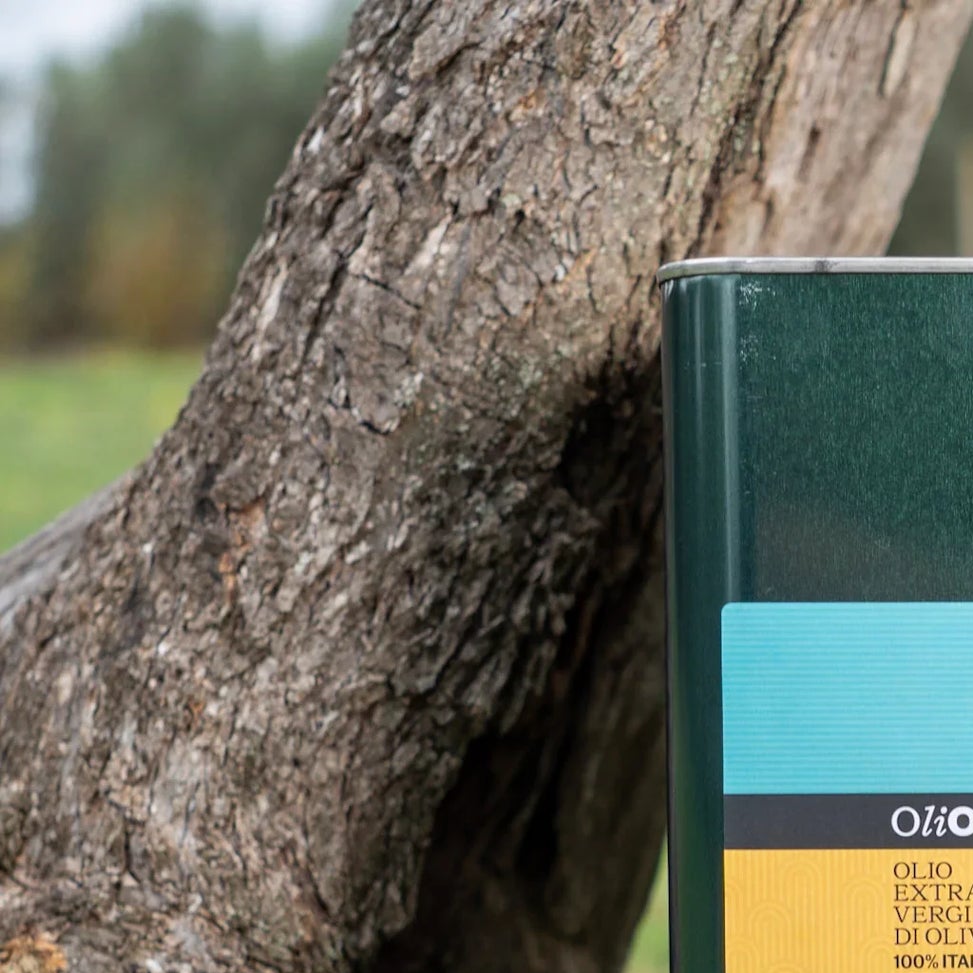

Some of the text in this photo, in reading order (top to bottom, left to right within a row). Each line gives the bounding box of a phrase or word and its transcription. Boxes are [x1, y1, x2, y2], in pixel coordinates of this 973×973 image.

[893, 862, 953, 880] OLIO
[894, 927, 919, 945] DI
[894, 954, 939, 969] 100%
